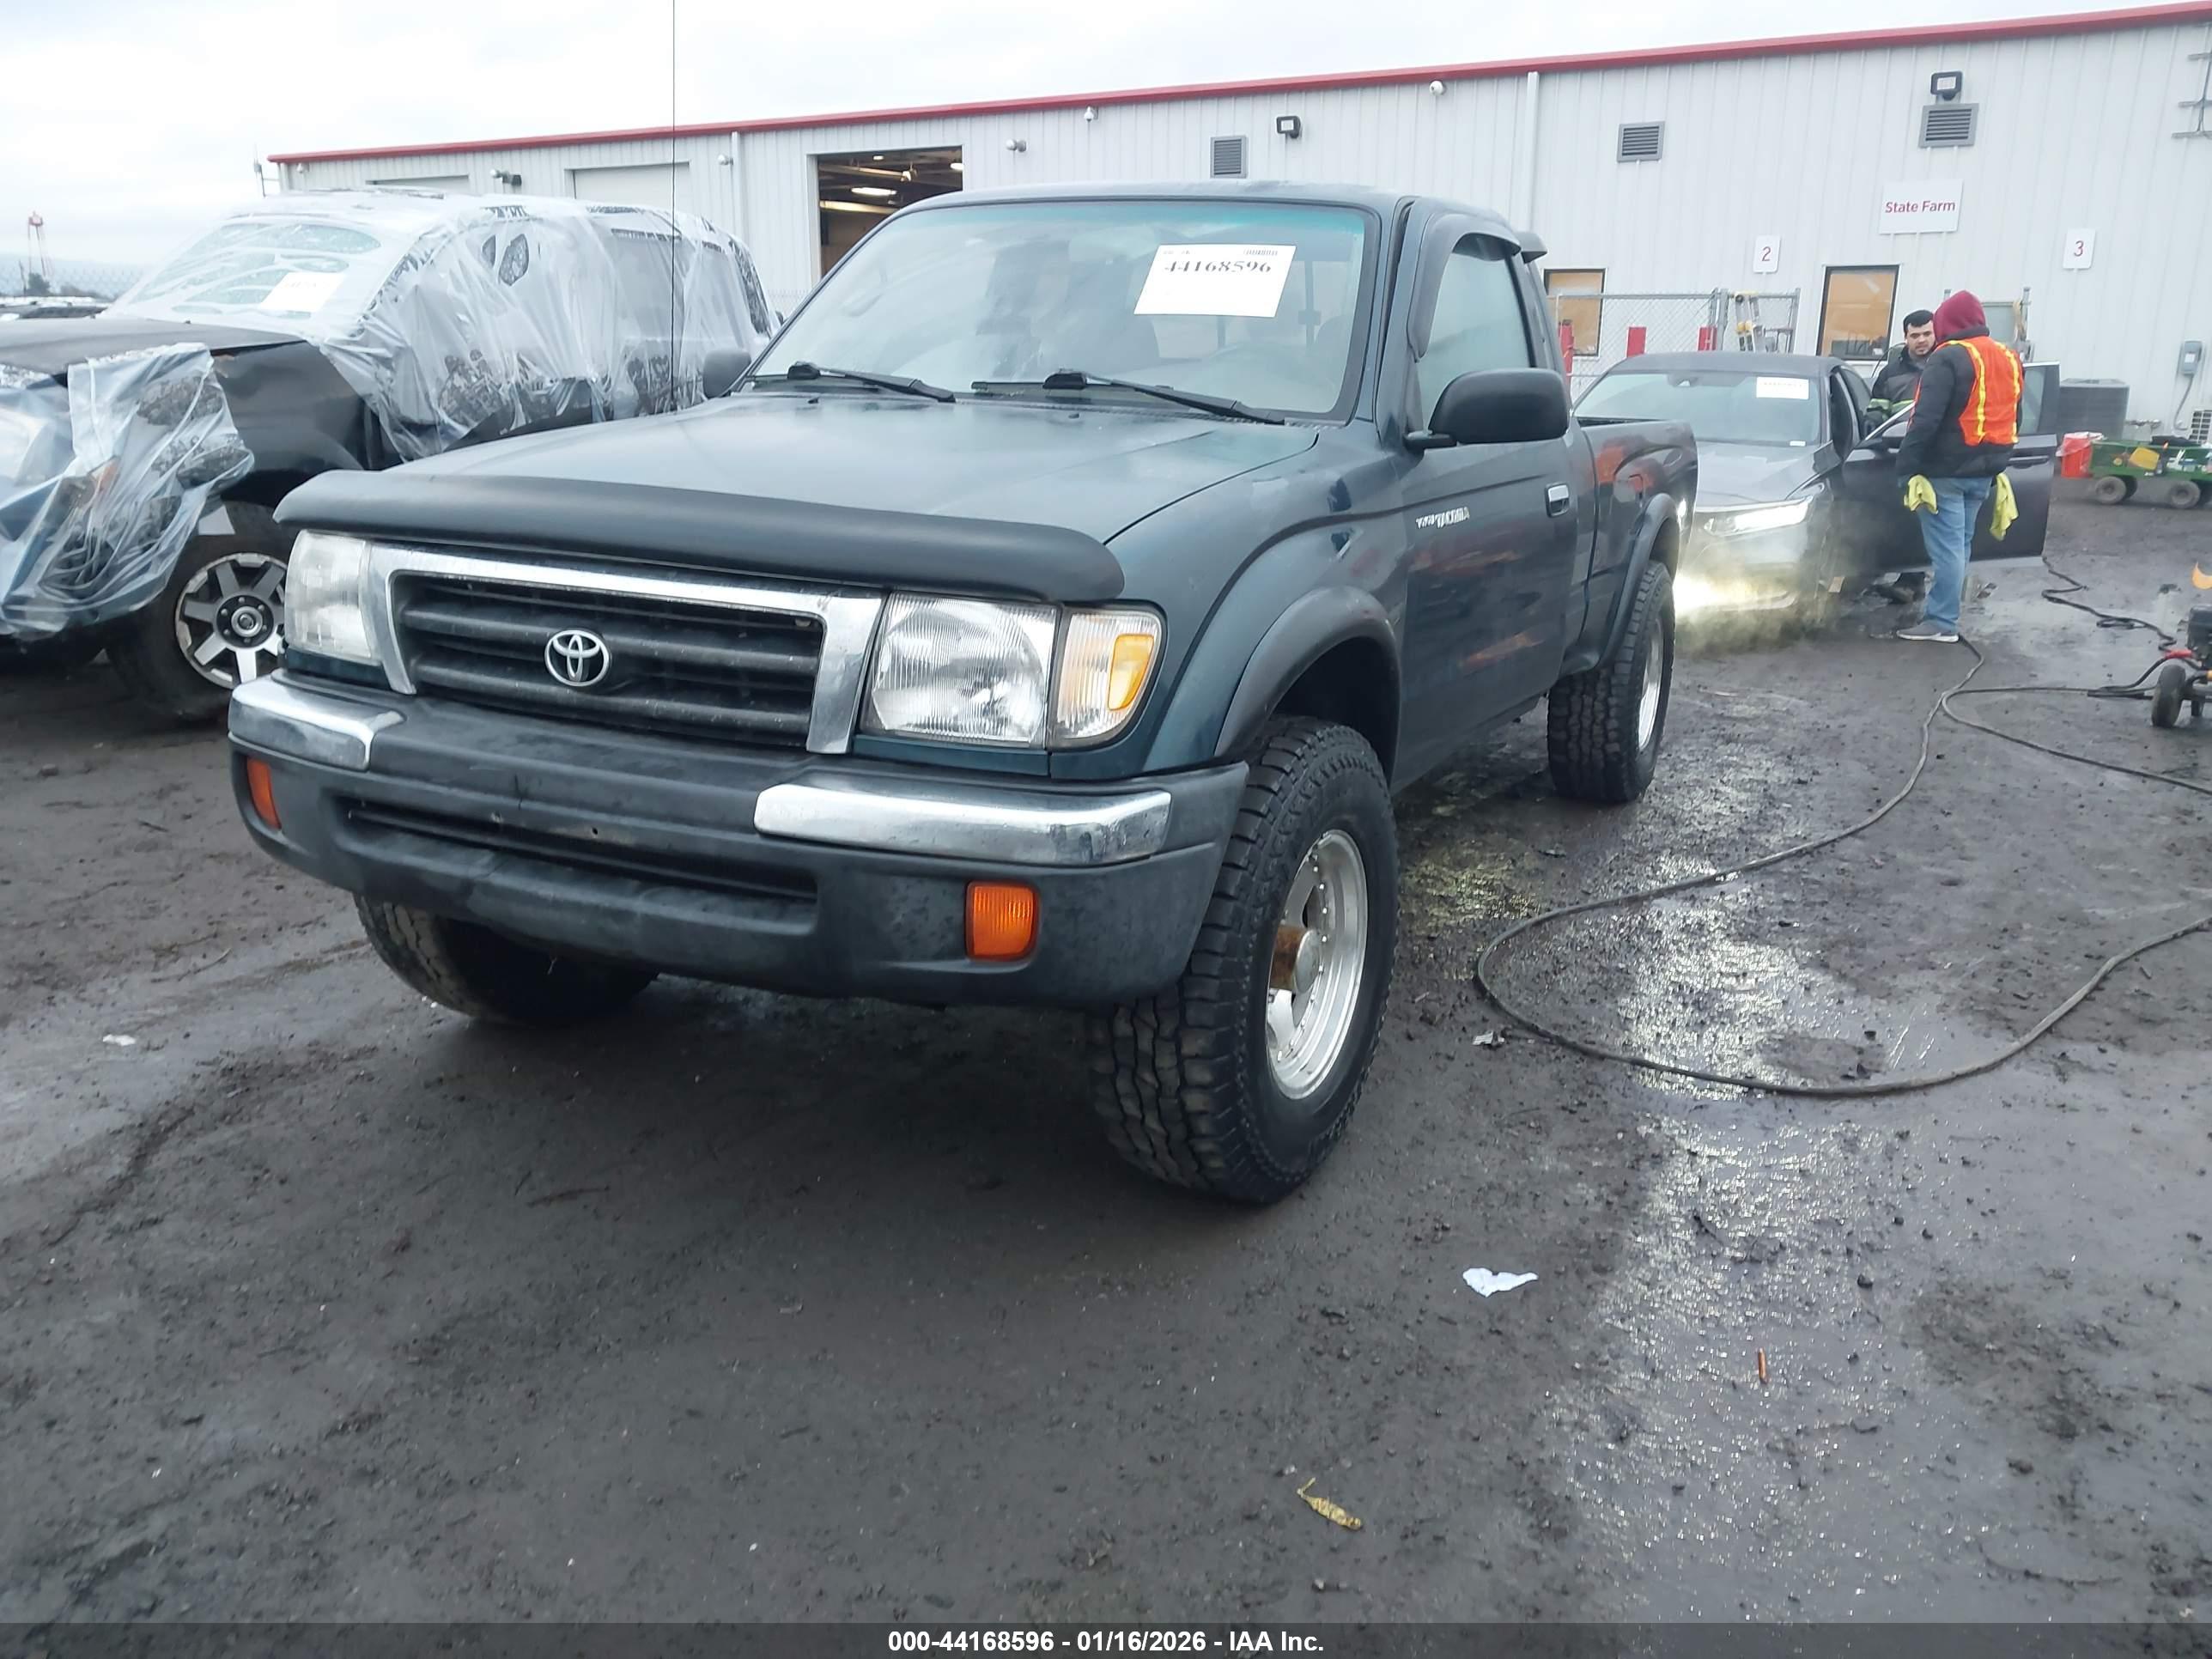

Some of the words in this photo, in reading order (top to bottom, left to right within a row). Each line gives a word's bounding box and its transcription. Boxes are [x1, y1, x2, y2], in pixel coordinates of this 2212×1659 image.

[1885, 201, 1918, 214] State
[1922, 200, 1956, 212] Farm
[1761, 246, 1771, 262] 2
[2074, 240, 2084, 257] 3
[1164, 260, 1272, 273] 44168596
